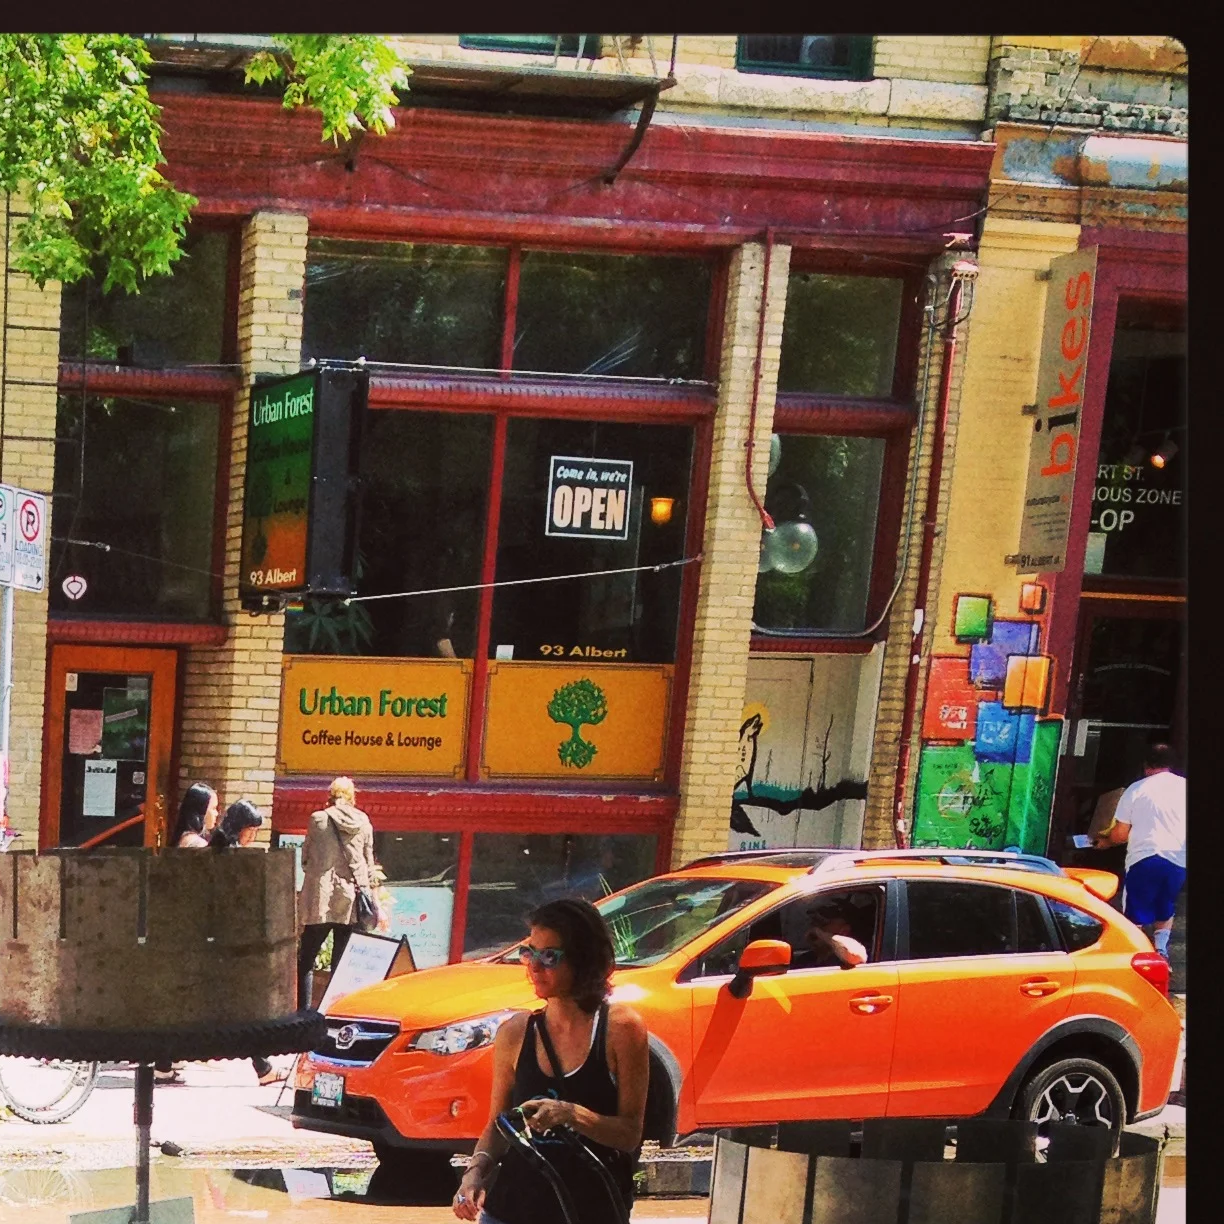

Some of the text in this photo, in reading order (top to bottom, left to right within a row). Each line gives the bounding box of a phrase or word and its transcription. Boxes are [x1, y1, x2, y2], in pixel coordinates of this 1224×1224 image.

[1035, 271, 1092, 477] bikes
[253, 387, 314, 427] Urban Forest
[556, 465, 584, 479] Come
[601, 470, 627, 482] we're
[1136, 488, 1182, 505] ZONE
[553, 485, 626, 530] OPEN
[250, 567, 297, 585] 93 Albert
[539, 644, 628, 657] 93 Albert
[299, 686, 448, 718] Urban Forest
[302, 729, 442, 750] Coffee House & Lounge
